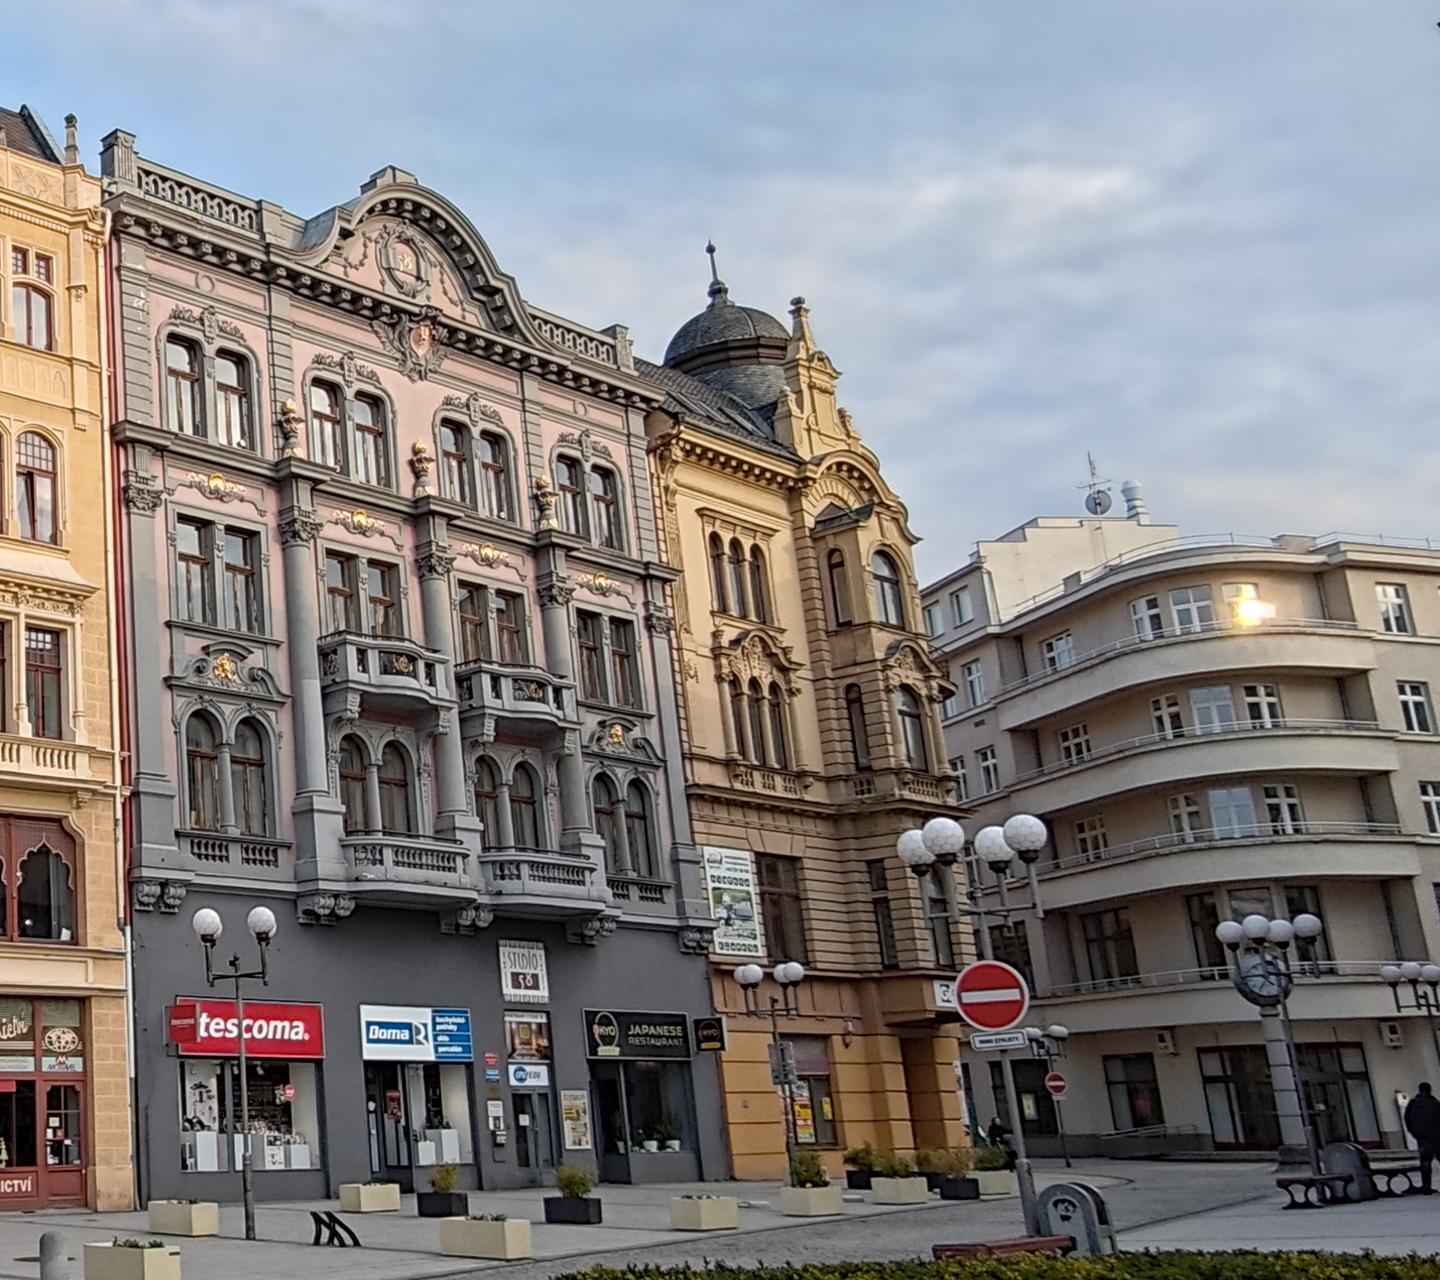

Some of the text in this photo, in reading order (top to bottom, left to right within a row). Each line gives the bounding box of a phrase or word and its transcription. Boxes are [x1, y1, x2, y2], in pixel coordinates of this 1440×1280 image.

[507, 951, 538, 971] STUDIO
[368, 1025, 410, 1041] Doma
[627, 1024, 683, 1037] JAPANESE
[628, 1036, 684, 1047] RESTAURANT
